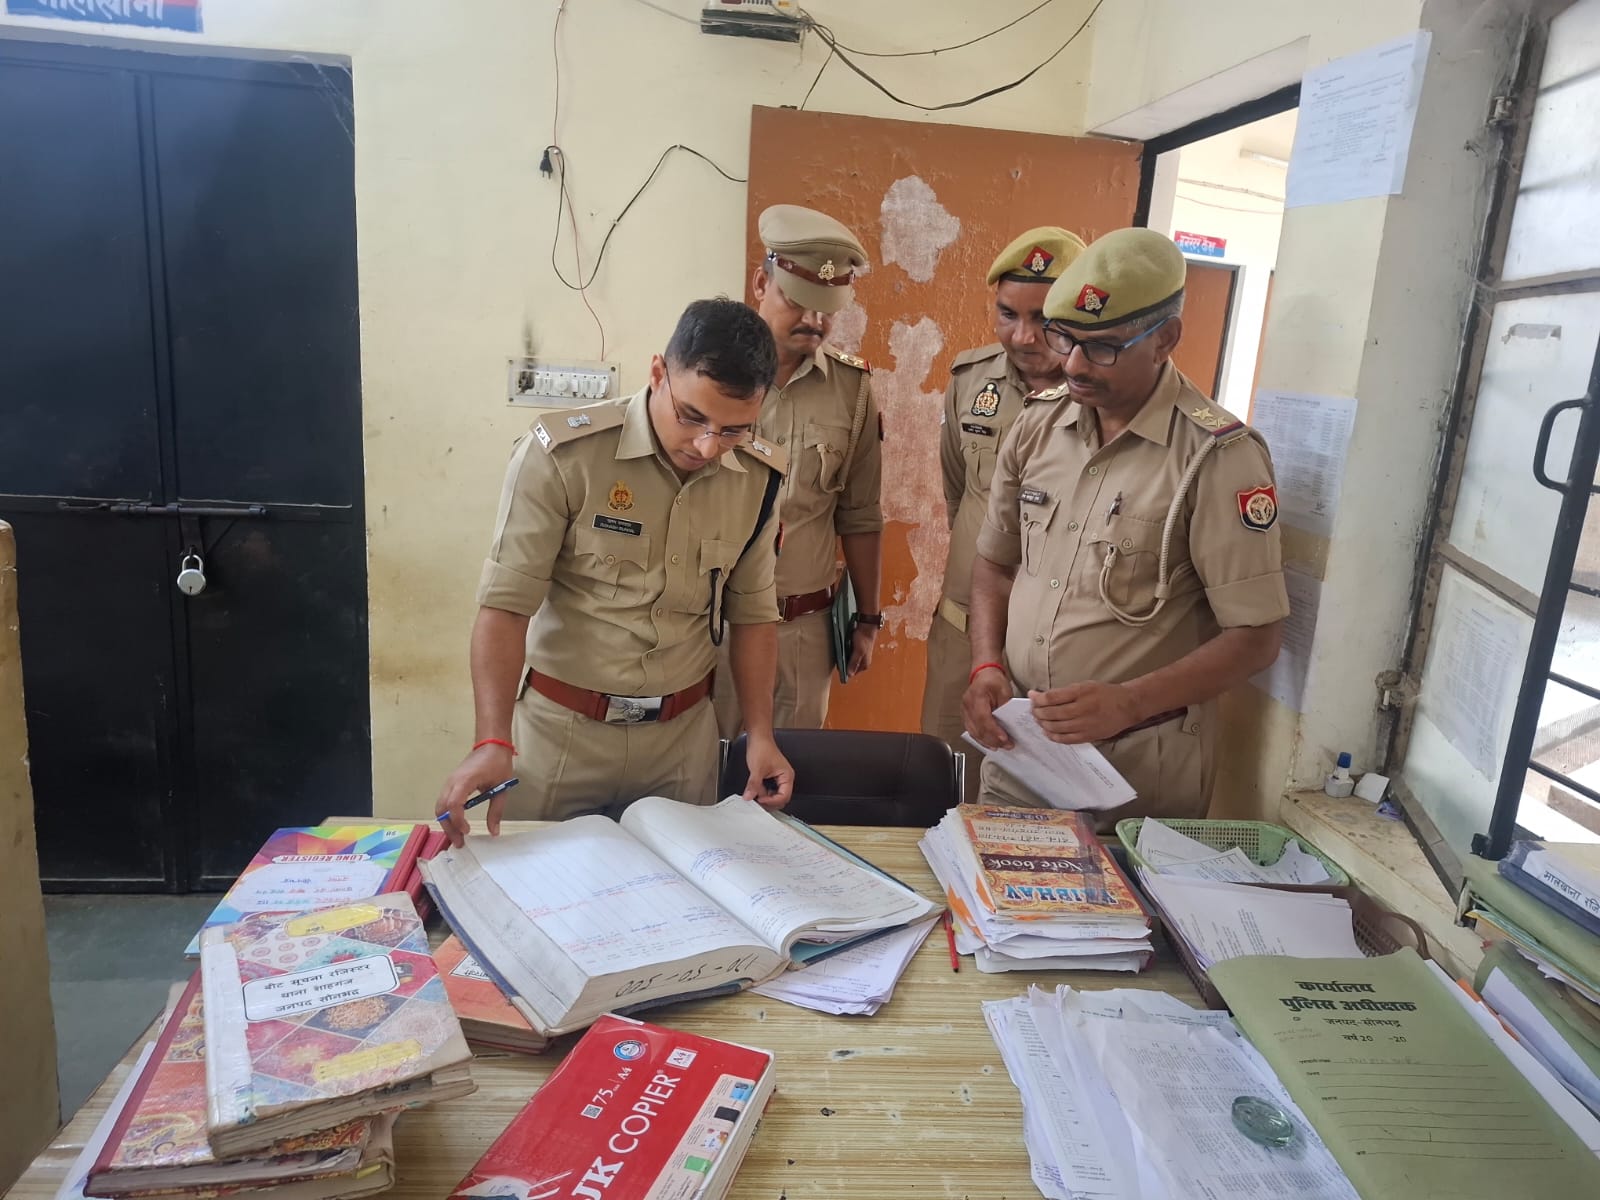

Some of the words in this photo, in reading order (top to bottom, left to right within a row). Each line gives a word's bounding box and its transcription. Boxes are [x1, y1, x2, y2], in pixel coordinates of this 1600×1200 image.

[335, 854, 364, 862] LONG
[989, 858, 1035, 870] book
[1040, 859, 1084, 872] Note
[264, 981, 285, 991] बीट
[289, 973, 323, 986] सूचना
[1294, 980, 1377, 993] कार्यालय
[280, 988, 307, 999] थाना
[275, 999, 313, 1012] जनपद
[1278, 995, 1338, 1012] पुलिस
[1339, 998, 1417, 1012] अधीक्षक
[591, 1086, 615, 1106] 75
[617, 1066, 633, 1081] A4
[571, 1156, 625, 1200] JK
[607, 1073, 682, 1154] COPIER
